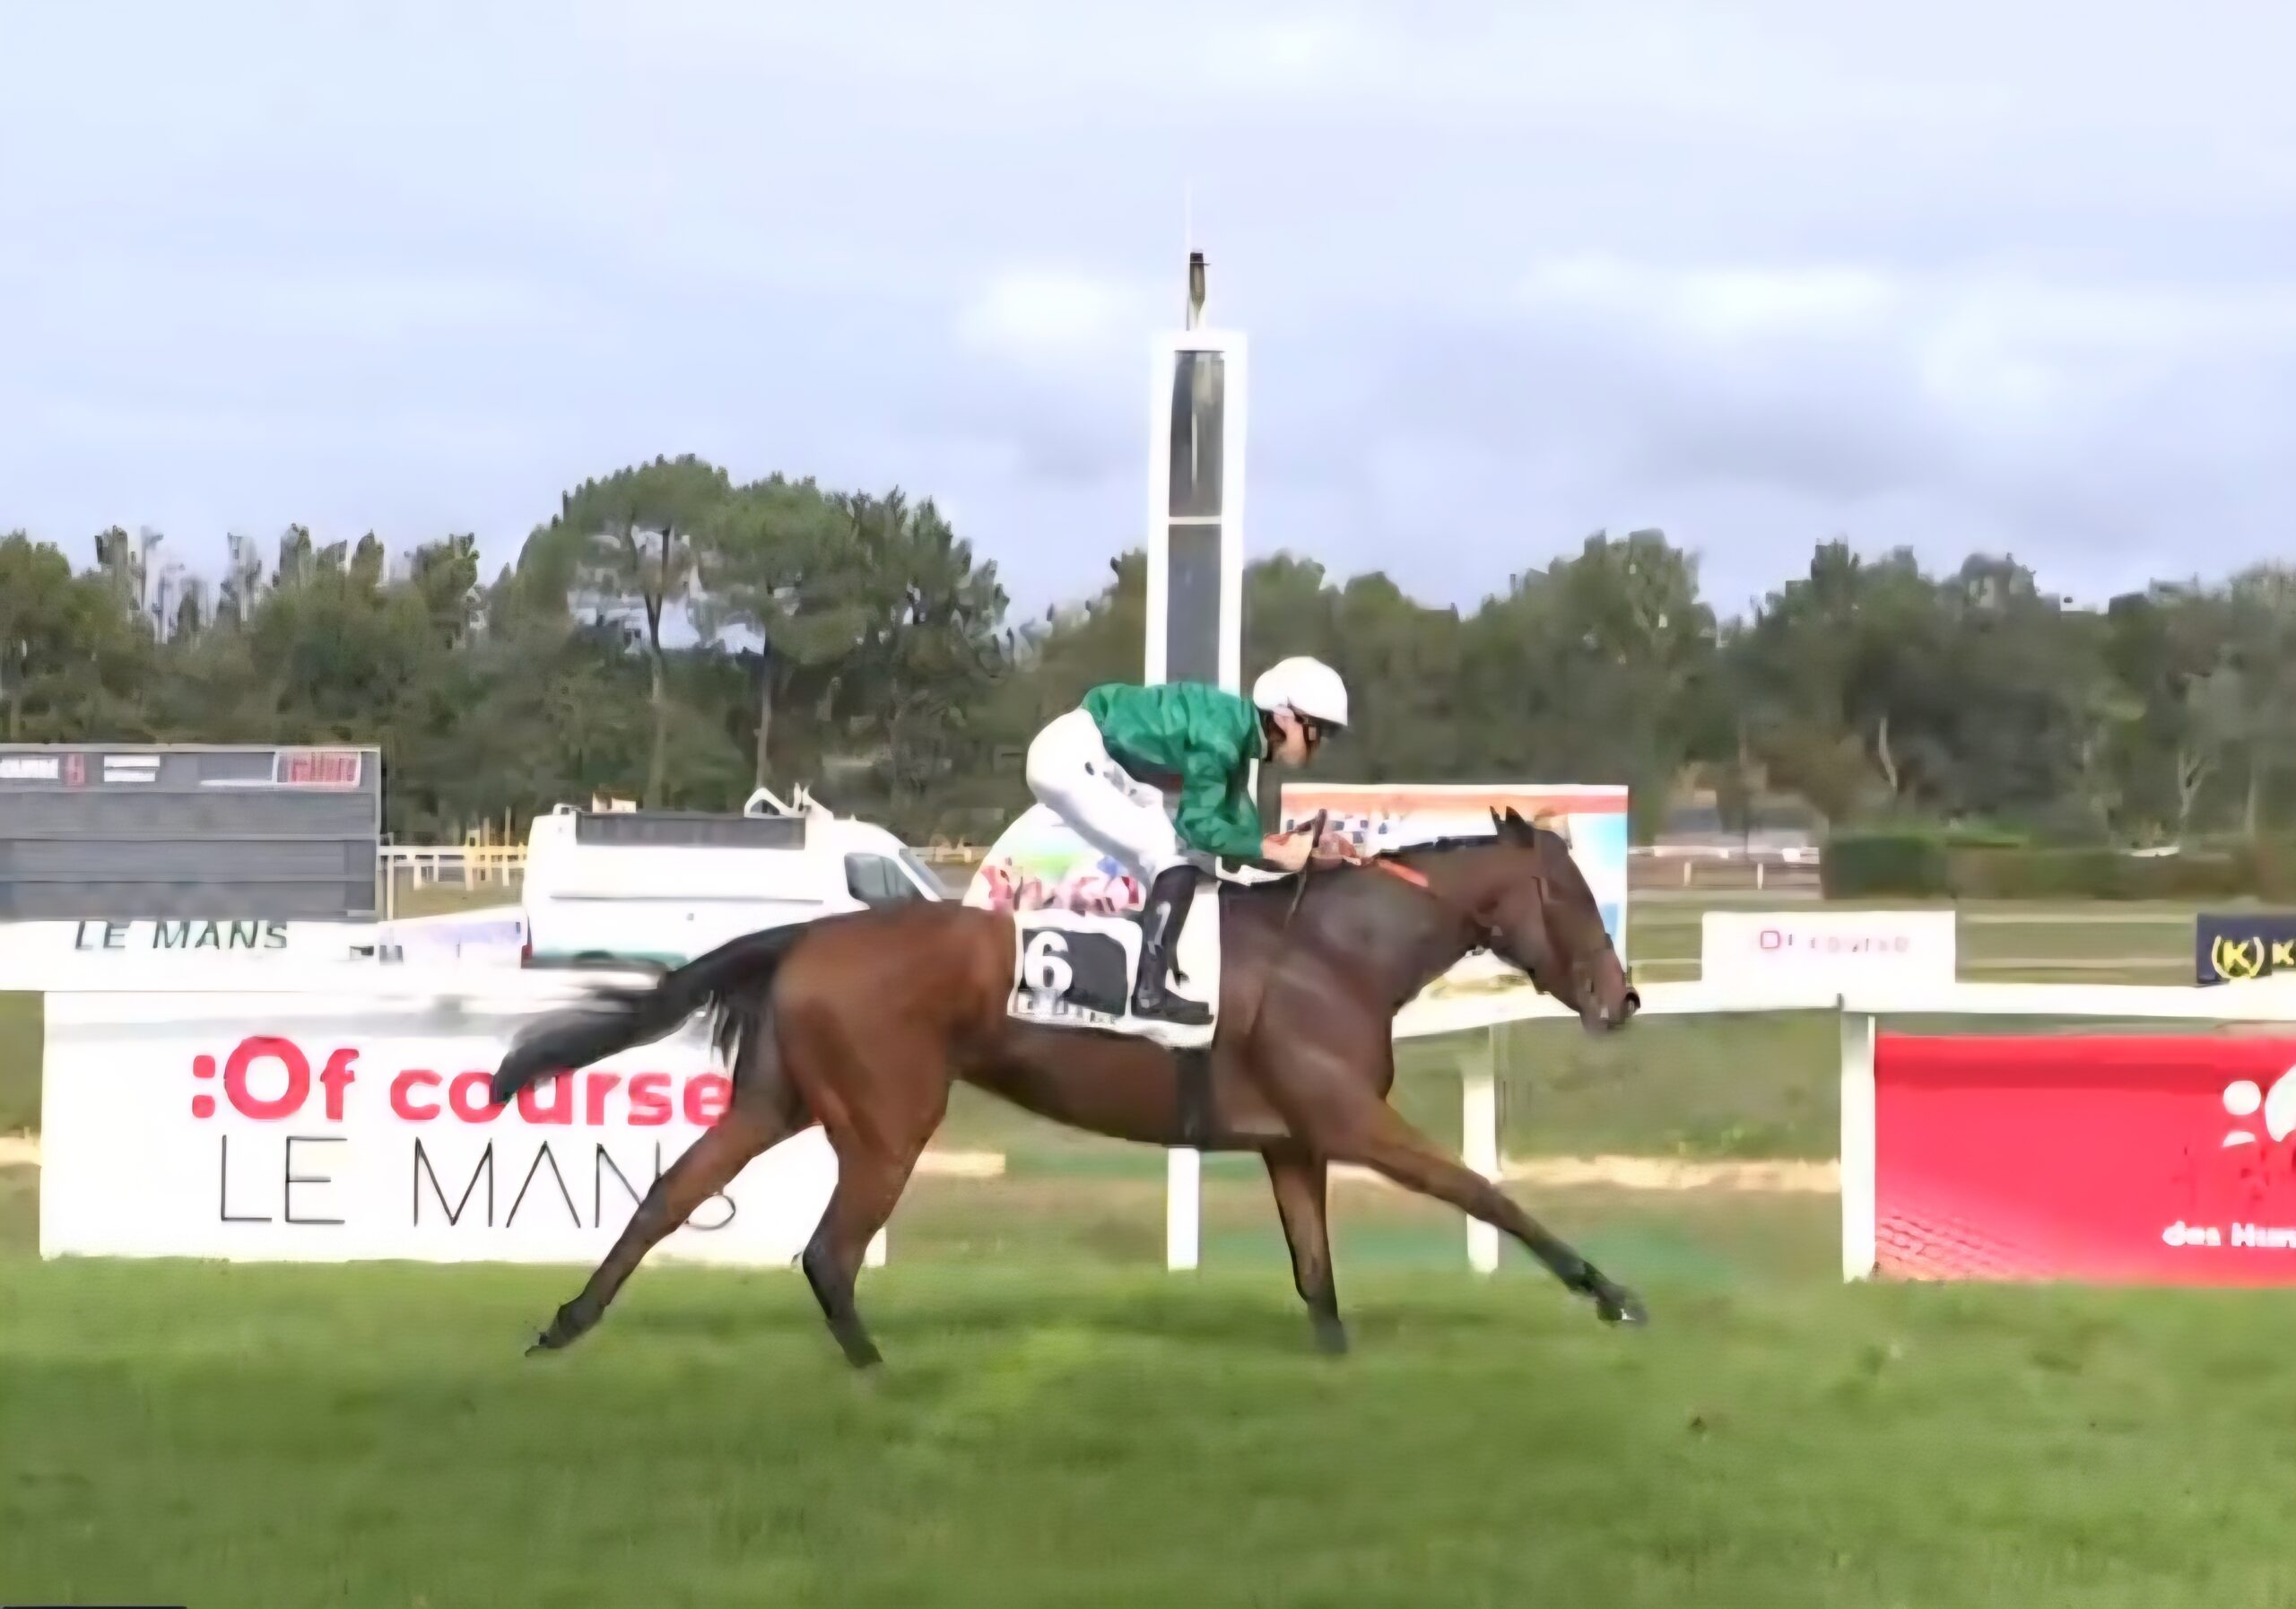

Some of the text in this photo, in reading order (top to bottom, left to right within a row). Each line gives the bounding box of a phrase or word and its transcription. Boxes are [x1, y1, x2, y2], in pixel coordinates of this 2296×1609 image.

[75, 920, 287, 949] LE MANS
[1023, 930, 1074, 992] 6
[389, 1067, 733, 1126] course
[220, 1134, 348, 1225] LE
